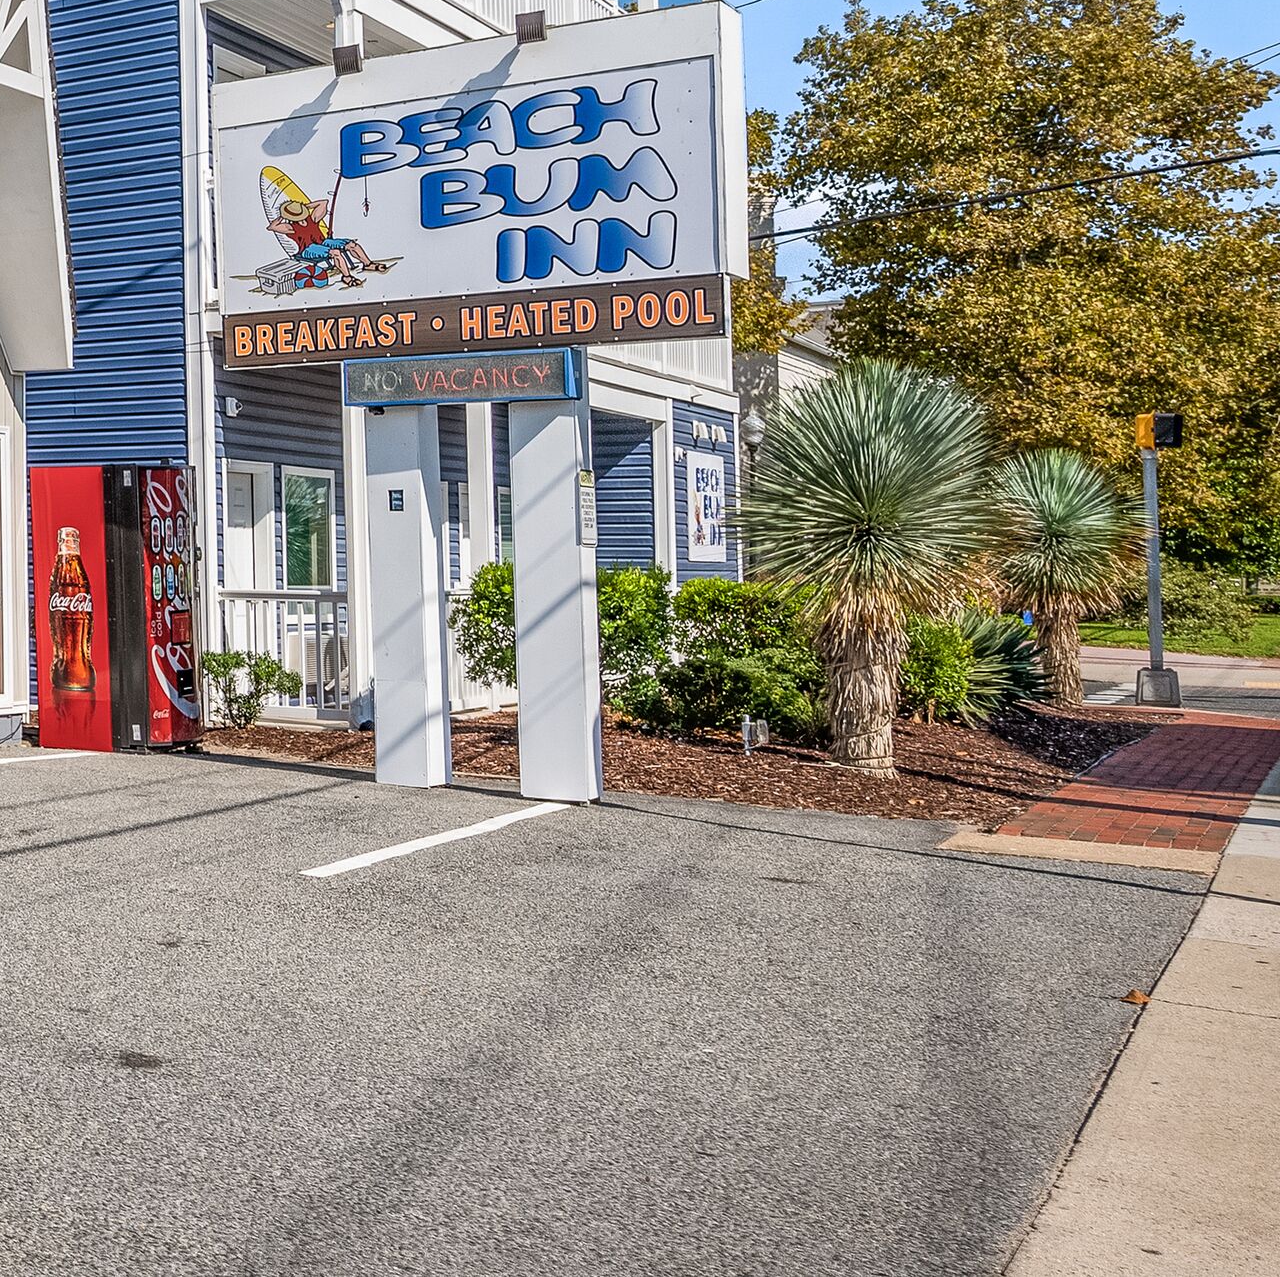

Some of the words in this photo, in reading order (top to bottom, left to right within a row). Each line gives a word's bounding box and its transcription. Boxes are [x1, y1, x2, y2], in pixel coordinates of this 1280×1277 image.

[340, 79, 661, 179] BEACH
[420, 146, 678, 229] BUM
[496, 210, 678, 283] INN
[233, 310, 417, 359] BREAKFAST
[459, 296, 599, 342] HEATED
[610, 287, 716, 331] POOL
[363, 369, 402, 392] NO
[412, 364, 551, 392] VACANCY
[49, 592, 93, 612] Coca-Cola
